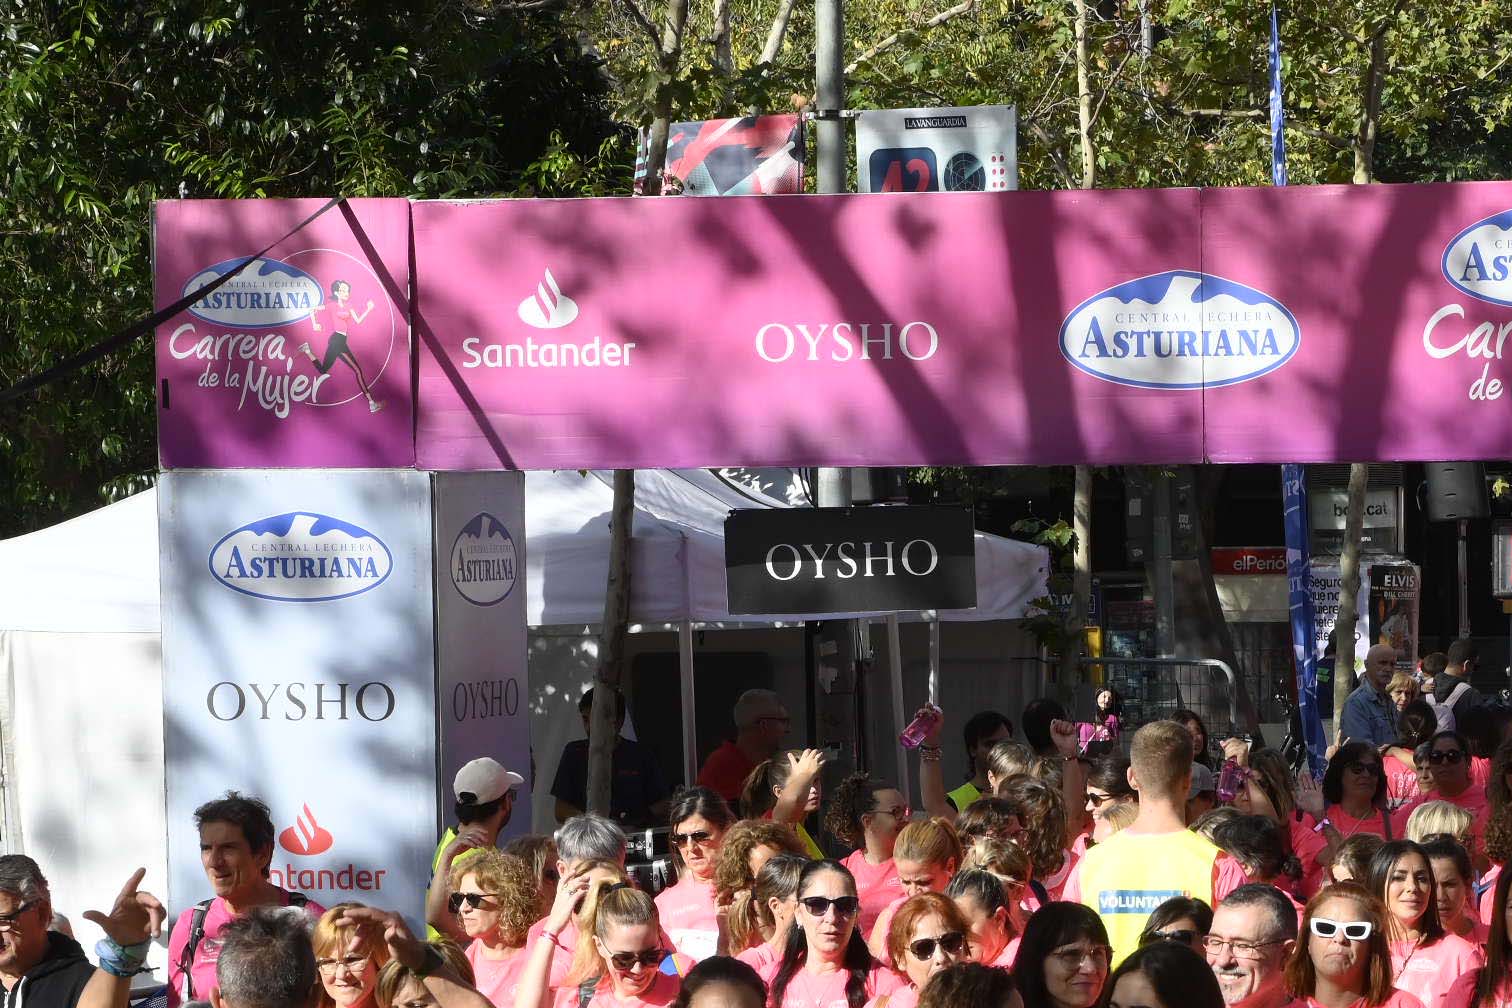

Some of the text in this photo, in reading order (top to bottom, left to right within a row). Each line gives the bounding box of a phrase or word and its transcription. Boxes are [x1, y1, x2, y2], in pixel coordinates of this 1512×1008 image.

[916, 117, 967, 128] VANGUARDIA
[193, 282, 311, 310] ASTURIANA
[215, 280, 259, 289] ENTRAL
[1115, 311, 1274, 325] CENTRAL LECHERA
[169, 323, 286, 360] Carrera
[462, 335, 637, 369] Santander
[754, 321, 939, 363] OYSHO
[1078, 315, 1281, 361] ASTURIANA
[198, 358, 331, 419] de la Mujer
[1469, 363, 1503, 401] de
[224, 545, 380, 579] ASTURIANA
[251, 543, 374, 552] CENTRAL LECHERA
[456, 547, 513, 584] ASTURIANA
[765, 539, 939, 581] OYSHO
[1384, 575, 1415, 587] ELVIS
[206, 681, 395, 722] OYSHO
[453, 677, 519, 722] OYSHO
